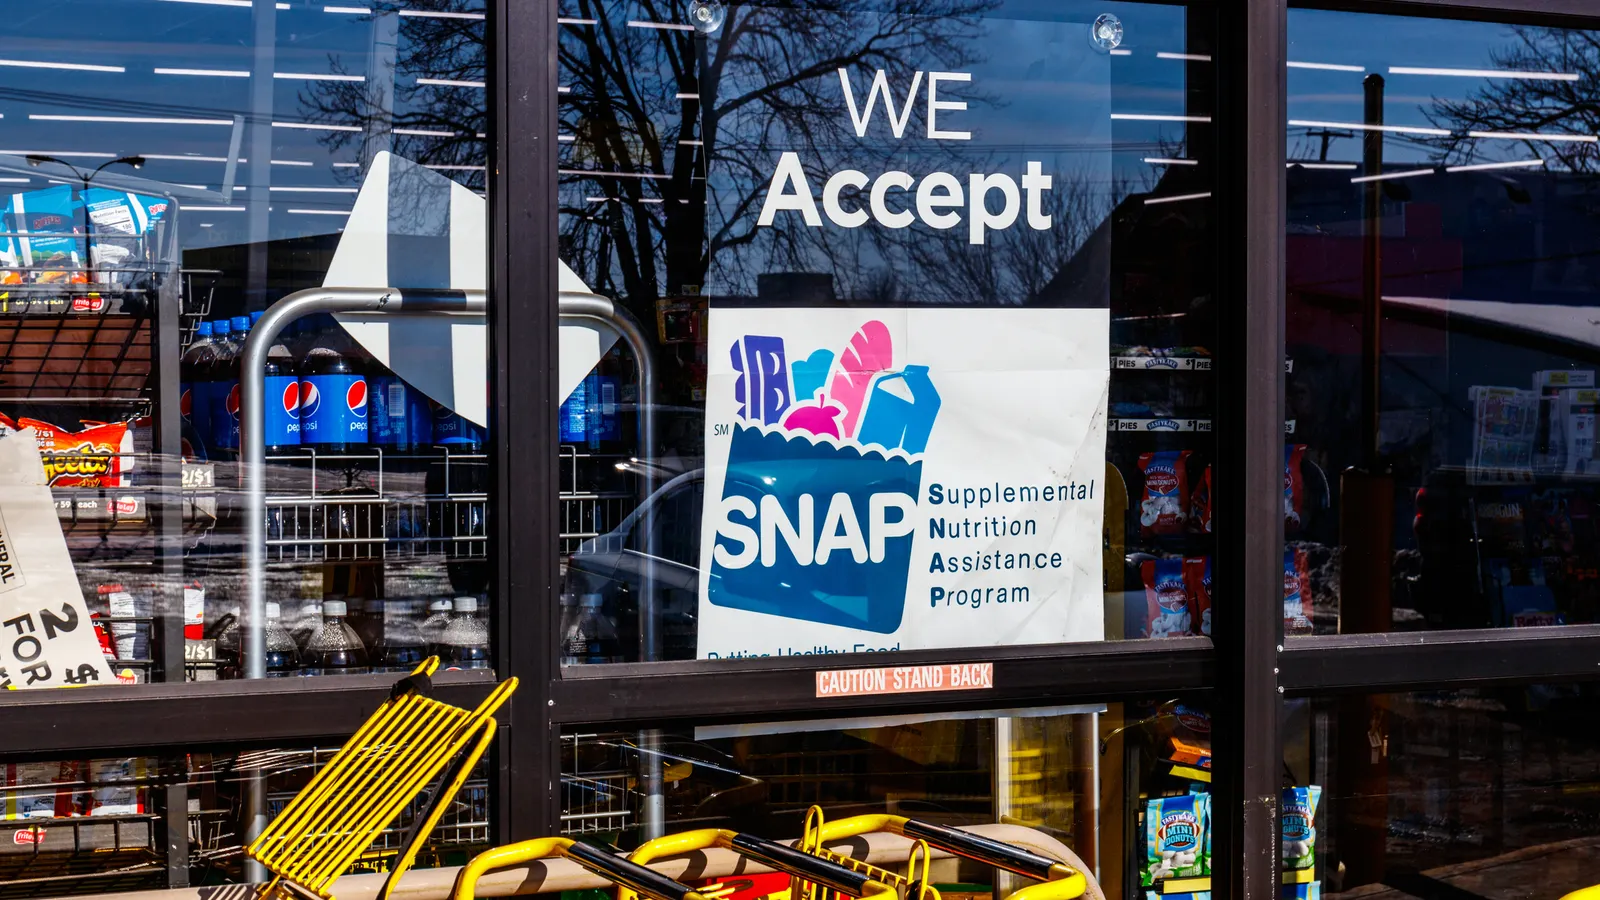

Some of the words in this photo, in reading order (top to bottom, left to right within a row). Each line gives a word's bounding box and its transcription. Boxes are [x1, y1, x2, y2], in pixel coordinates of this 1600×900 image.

[838, 68, 971, 140] WE
[757, 152, 1052, 244] Accept
[713, 424, 729, 436] SM
[1120, 422, 1138, 430] PIES
[182, 468, 211, 484] 2/$1
[928, 479, 1095, 508] Supplemental
[713, 492, 917, 569] SNAP
[929, 516, 1036, 540] Nutrition
[929, 550, 1063, 573] Assistance
[930, 584, 1029, 609] Program
[39, 602, 79, 640] 2
[3, 613, 52, 686] FOR
[185, 644, 213, 660] 2/$1
[819, 669, 886, 694] CAUTION
[893, 666, 943, 690] STAND
[950, 664, 991, 687] BACK
[1161, 812, 1197, 826] TASTYKAKE
[1167, 824, 1193, 835] MINI
[1165, 833, 1195, 847] DONUTS
